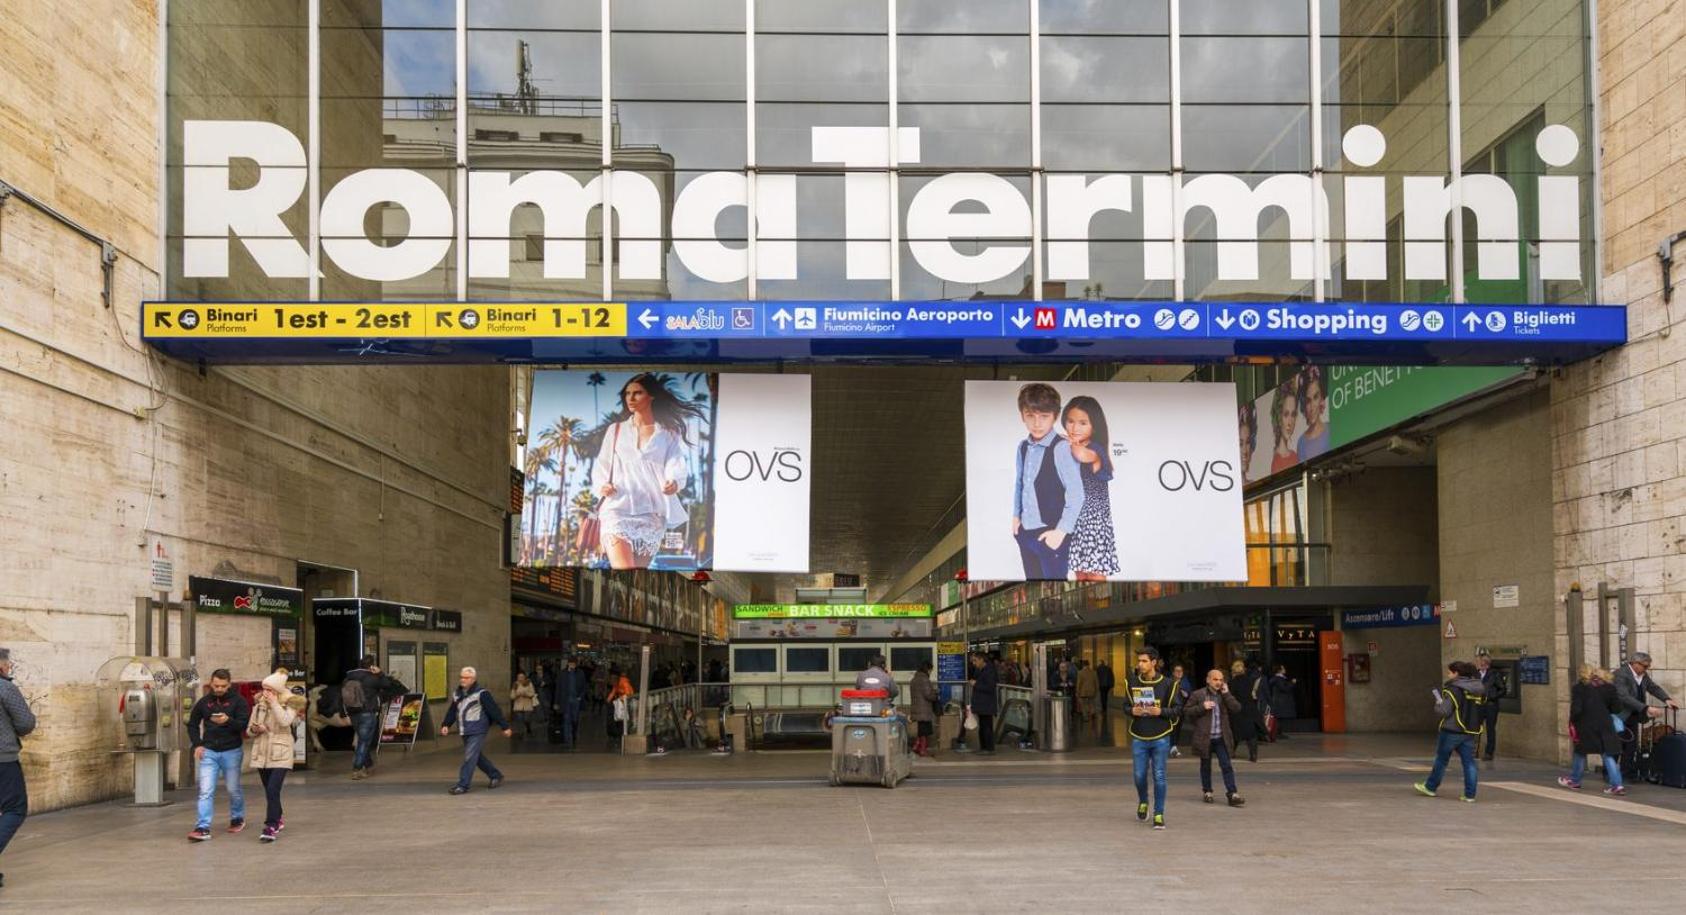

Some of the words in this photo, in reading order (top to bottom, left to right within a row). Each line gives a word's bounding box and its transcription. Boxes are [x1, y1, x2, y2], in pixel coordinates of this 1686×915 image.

[207, 308, 257, 321] Binari
[274, 308, 328, 328] 1est
[355, 308, 411, 328] 2est
[487, 308, 536, 321] Binari
[552, 308, 610, 328] 1-12
[824, 307, 901, 321] Fiumicino
[906, 307, 993, 324] Aeroporto
[1063, 308, 1141, 328] Metro
[1267, 308, 1387, 334] Shopping
[1513, 310, 1576, 327] Biglietti
[207, 323, 247, 333] Platforms
[487, 323, 526, 333] Platforms
[824, 322, 862, 332] Fiumicino
[864, 322, 895, 333] Airport
[1513, 326, 1541, 335] Tickets
[1332, 382, 1352, 409] OF
[725, 449, 802, 482] OVS
[1158, 459, 1234, 491] OVS
[736, 603, 783, 613] SANDWICH
[789, 604, 820, 617] BAR
[824, 604, 875, 617] SNACK
